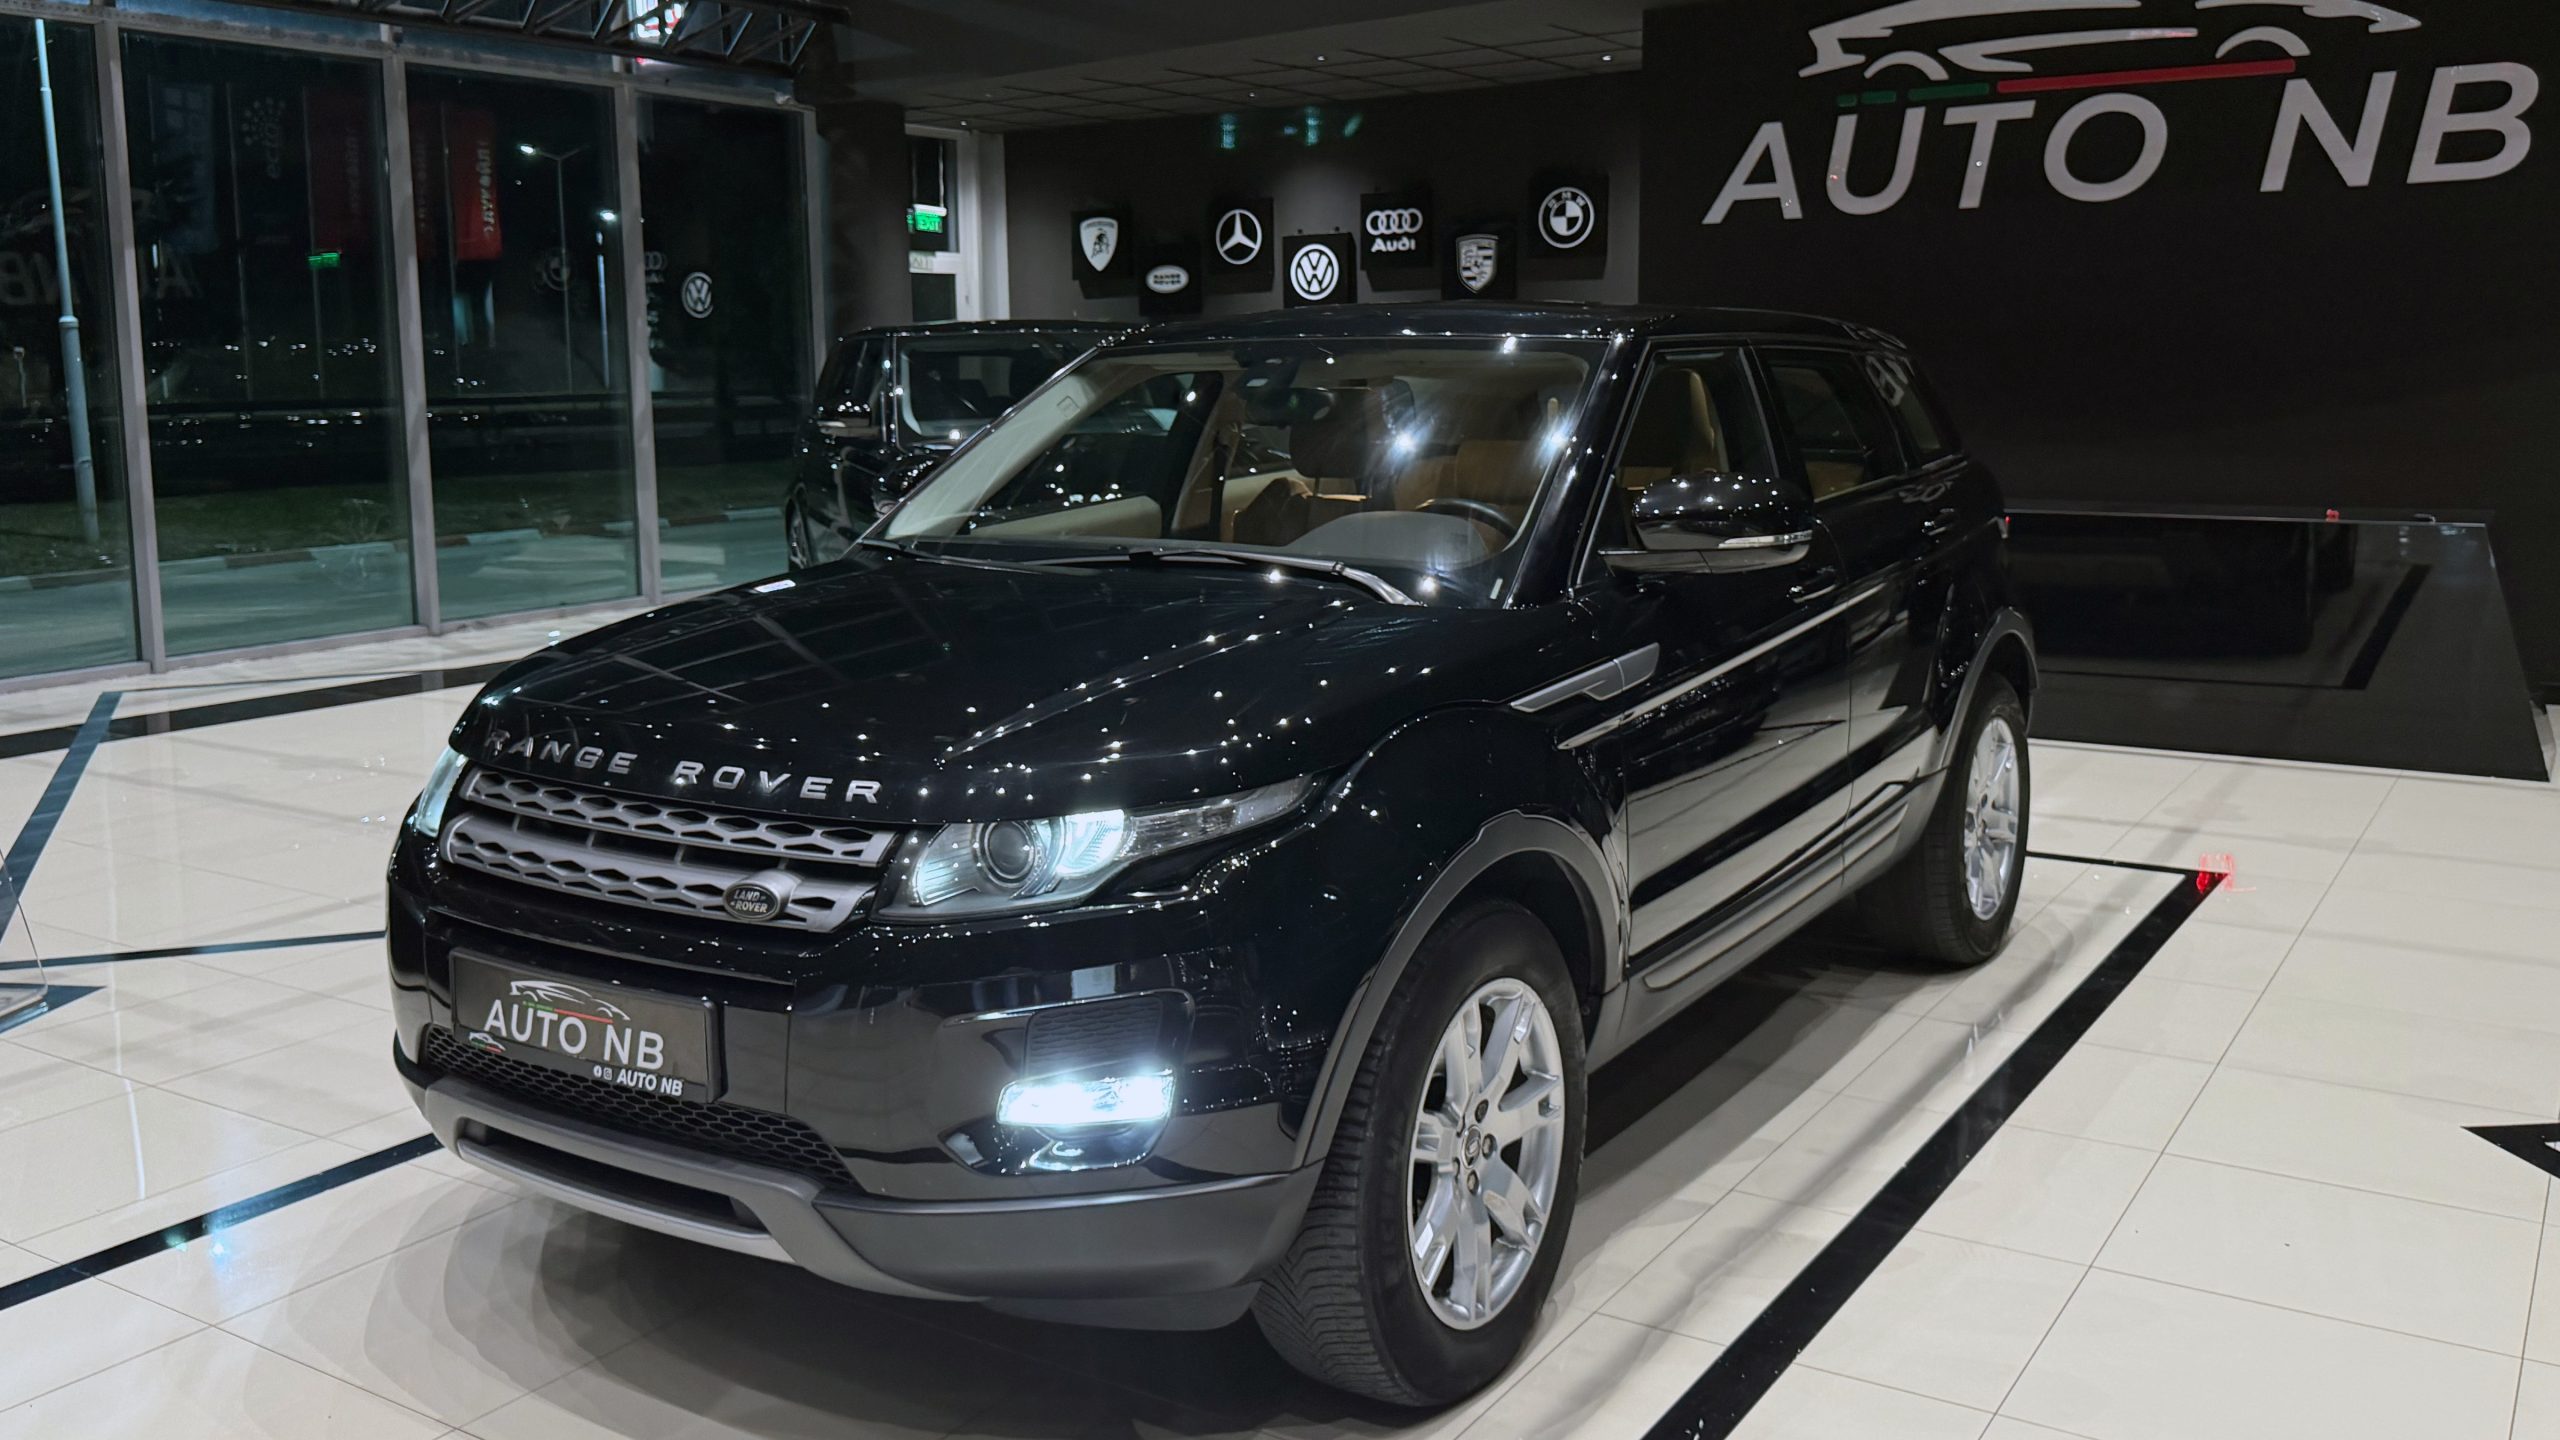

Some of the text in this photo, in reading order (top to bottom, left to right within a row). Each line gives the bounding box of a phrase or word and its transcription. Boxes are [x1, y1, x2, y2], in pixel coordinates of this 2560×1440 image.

[1701, 62, 2540, 224] AUTO NB
[1547, 190, 1587, 208] BMW
[1371, 235, 1416, 253] Audi
[484, 729, 883, 804] RANGE ROVER
[733, 889, 761, 901] LAND
[735, 900, 769, 914] ROVER
[484, 998, 665, 1071] AUTO NB
[616, 1069, 683, 1097] AUTO NB
